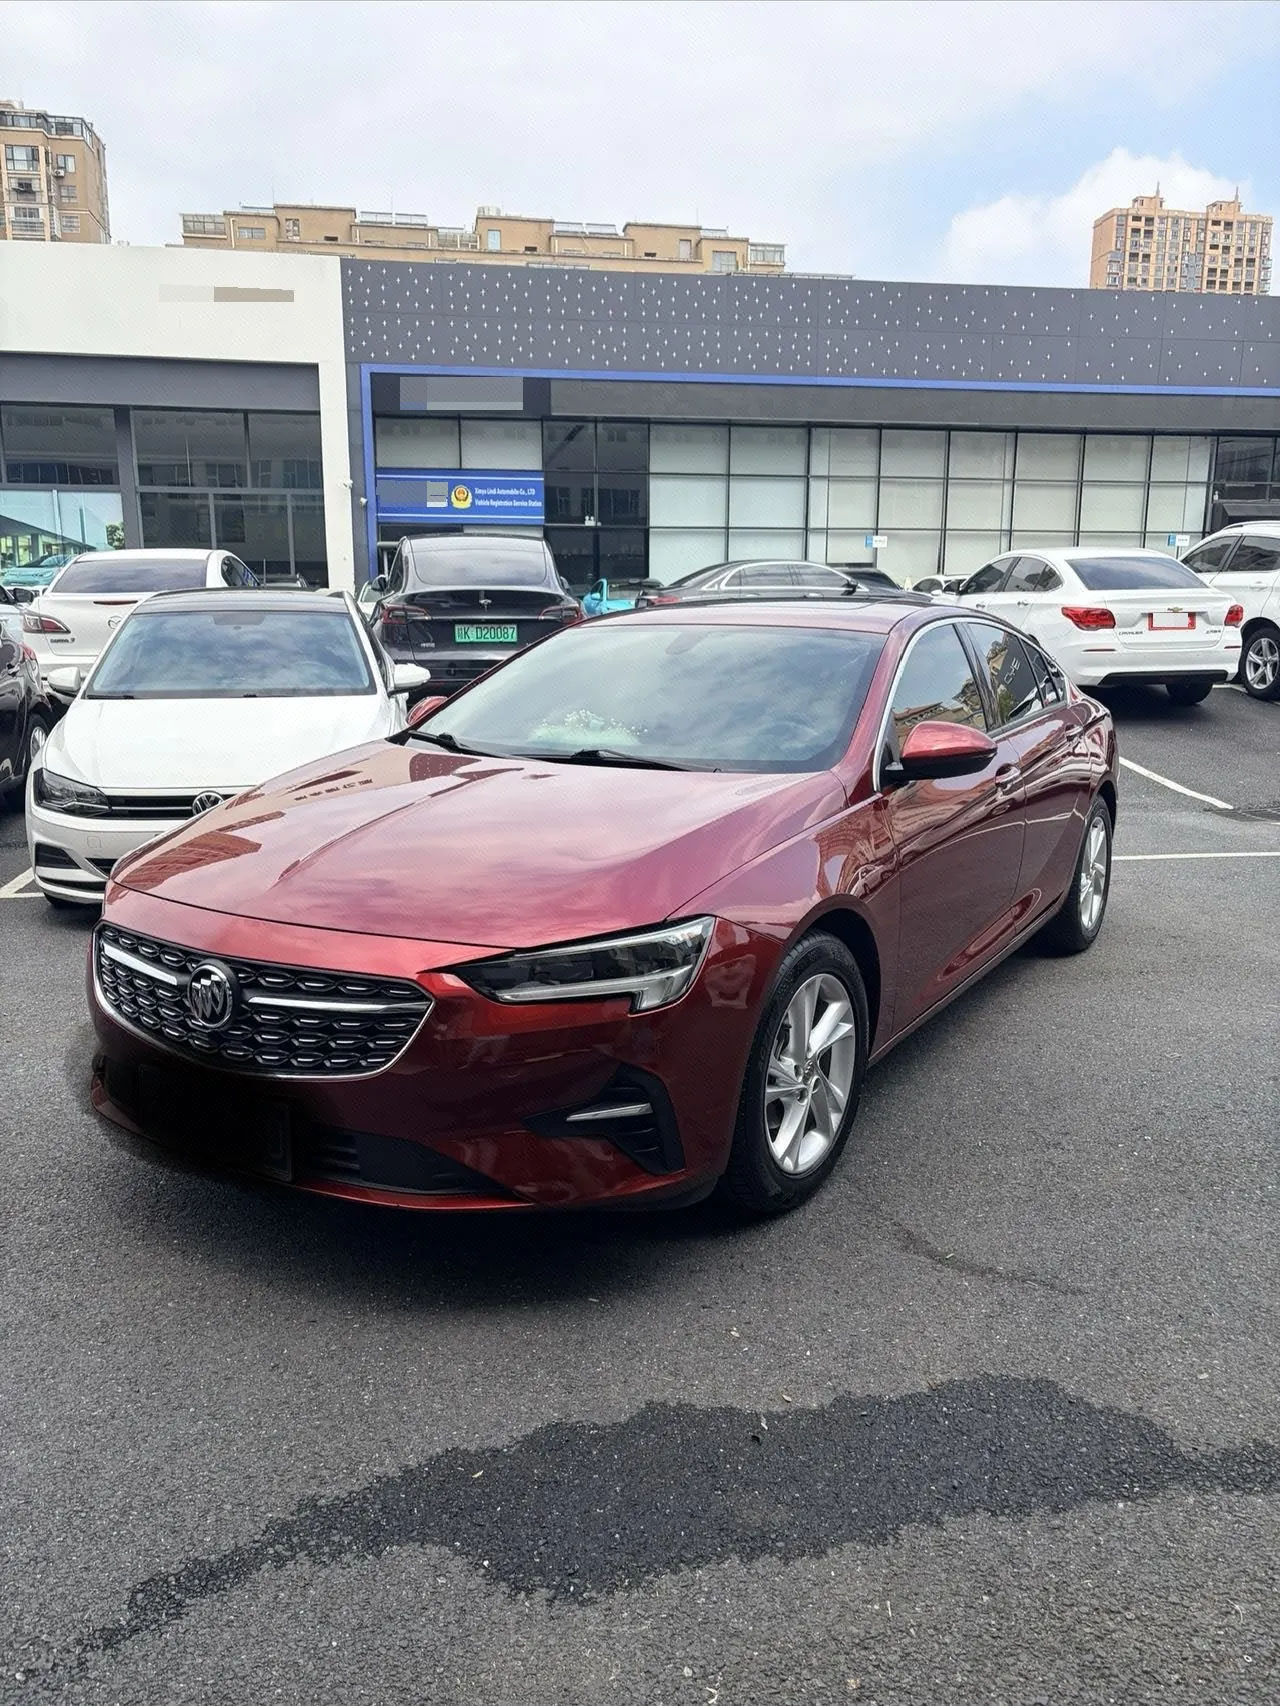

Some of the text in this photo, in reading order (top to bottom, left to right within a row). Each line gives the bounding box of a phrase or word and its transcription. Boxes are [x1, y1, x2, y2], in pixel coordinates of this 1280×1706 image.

[475, 499, 542, 508] Vehicle Registration Service Station
[475, 627, 515, 639] D20087
